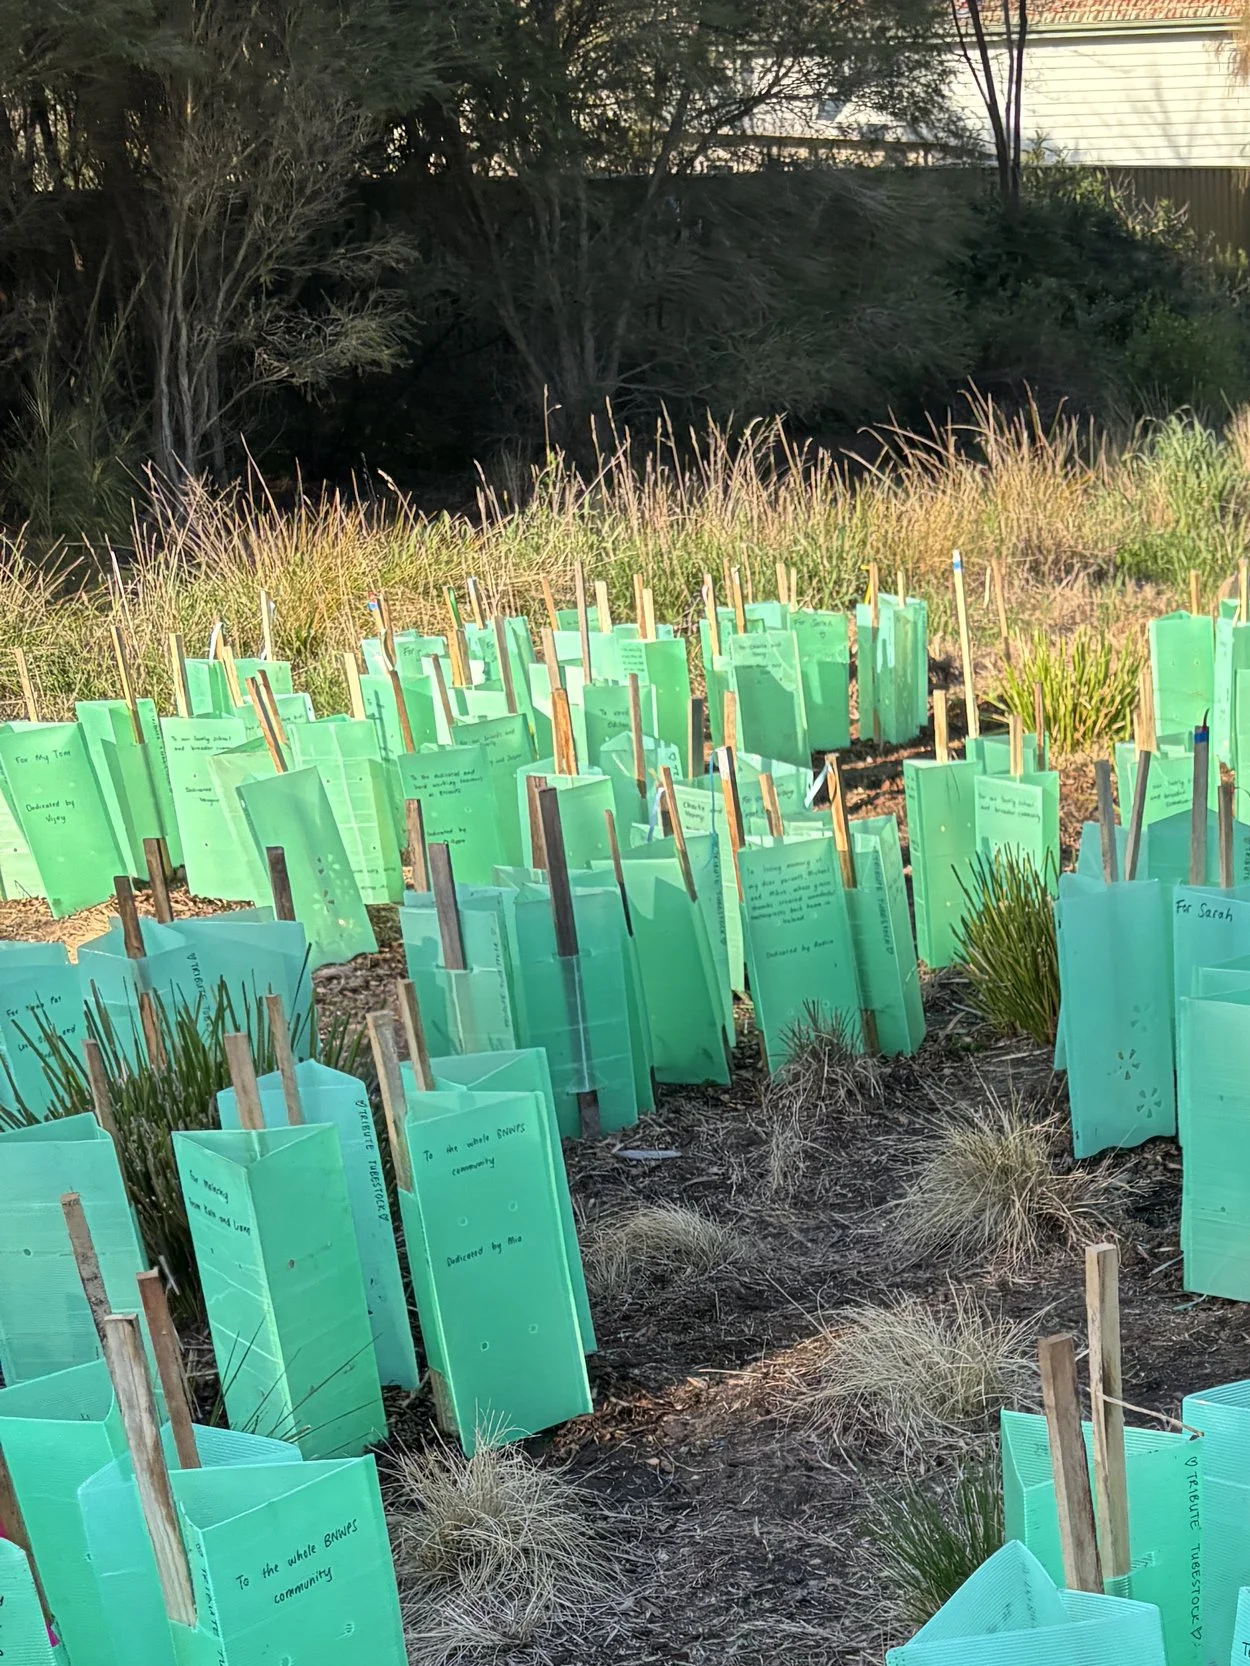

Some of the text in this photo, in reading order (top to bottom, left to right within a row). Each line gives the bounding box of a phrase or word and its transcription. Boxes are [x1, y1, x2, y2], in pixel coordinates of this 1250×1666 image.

[1176, 899, 1233, 922] For Sarah
[358, 1109, 387, 1212] TRIBUTE TUBESTOCK
[423, 1150, 433, 1162] To
[446, 1144, 458, 1154] the
[467, 1133, 490, 1149] whole
[451, 1157, 495, 1177] community
[447, 1246, 484, 1268] Dedicated
[491, 1241, 502, 1255] by
[236, 1519, 357, 1590] To the whole BNWPS
[1187, 1471, 1202, 1626] TRIBUTE TUBESTOCK
[274, 1566, 333, 1604] community
